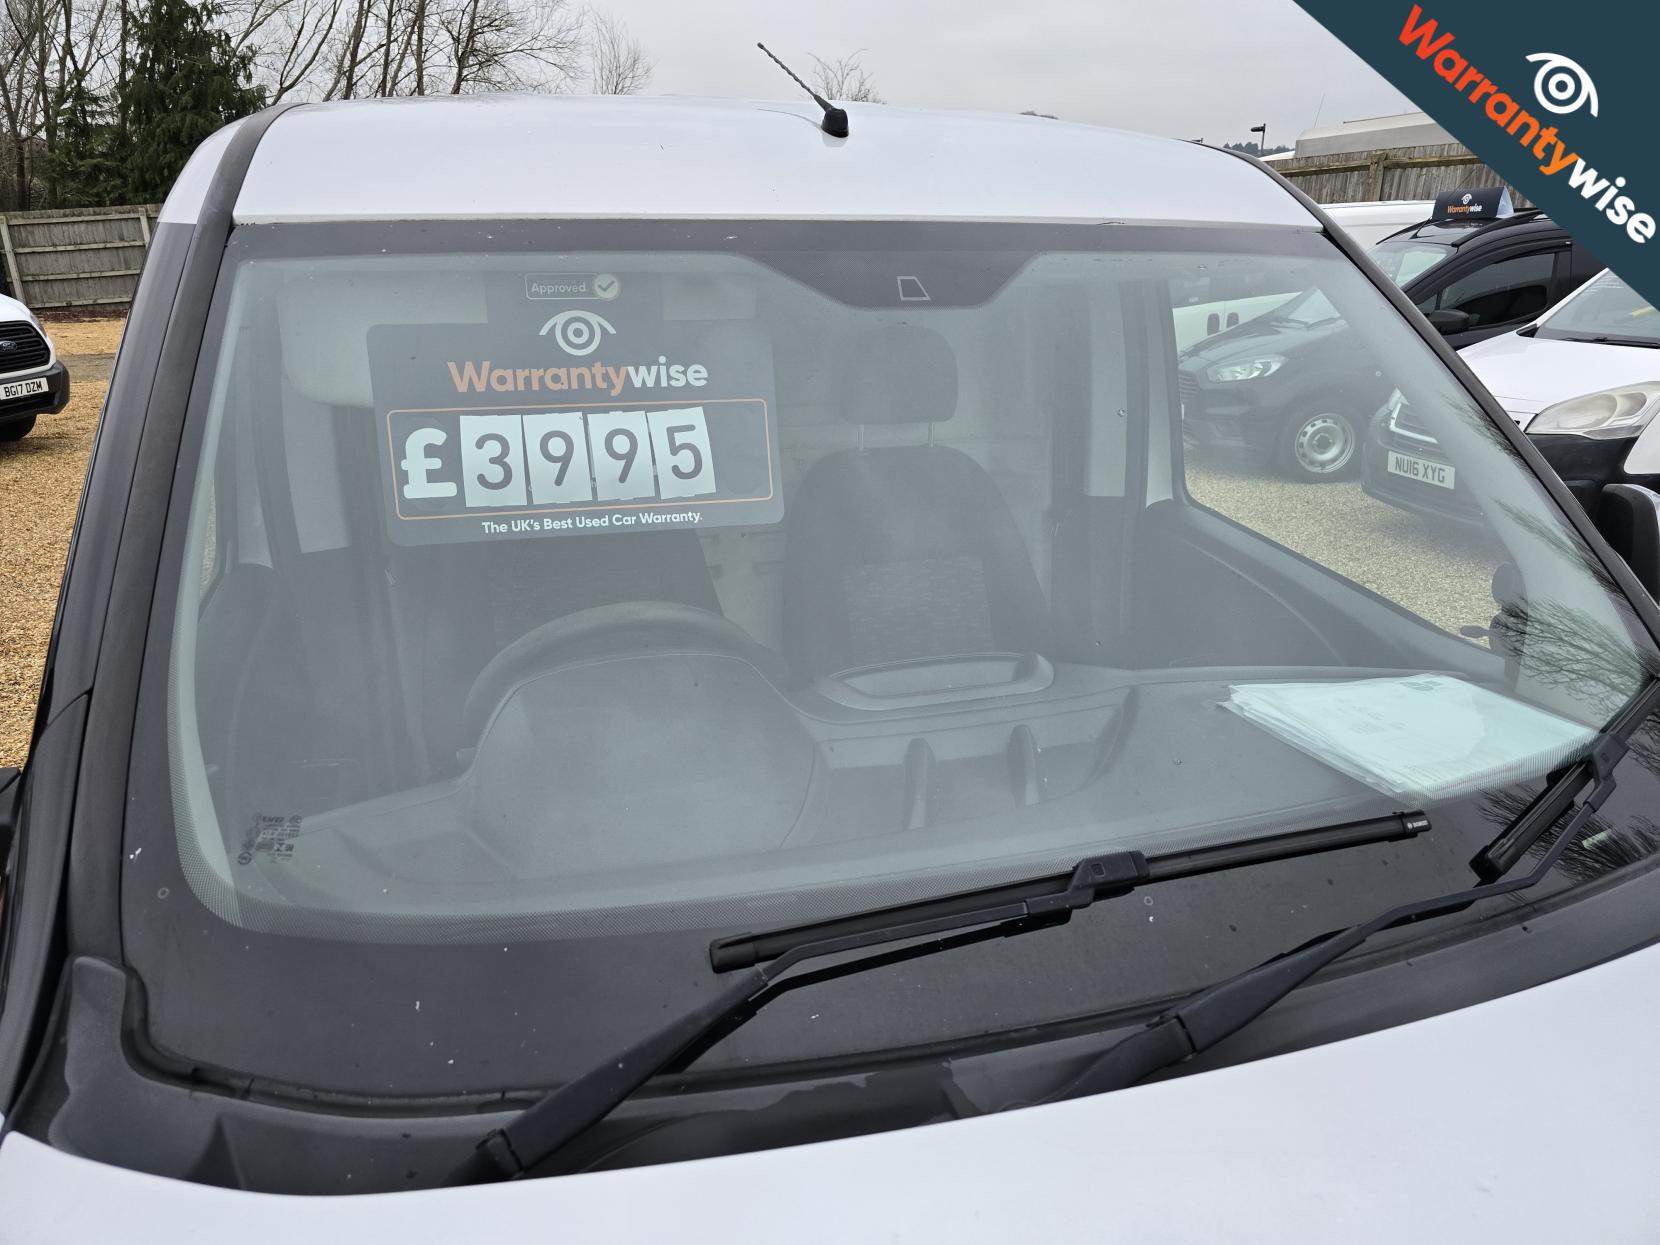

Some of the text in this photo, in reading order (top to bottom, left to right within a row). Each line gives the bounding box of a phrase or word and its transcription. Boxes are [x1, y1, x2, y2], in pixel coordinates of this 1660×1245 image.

[1447, 203, 1482, 214] Warrantywise
[531, 282, 587, 294] Approved
[447, 355, 708, 396] Warrantywise
[4, 380, 43, 397] BG17 DZM
[401, 424, 704, 499] £3995
[1395, 456, 1446, 483] NU16 XYG
[482, 521, 508, 534] The
[543, 517, 573, 530] Best
[576, 515, 609, 528] Used
[612, 514, 637, 526] Car
[639, 511, 703, 525] Warranty.
